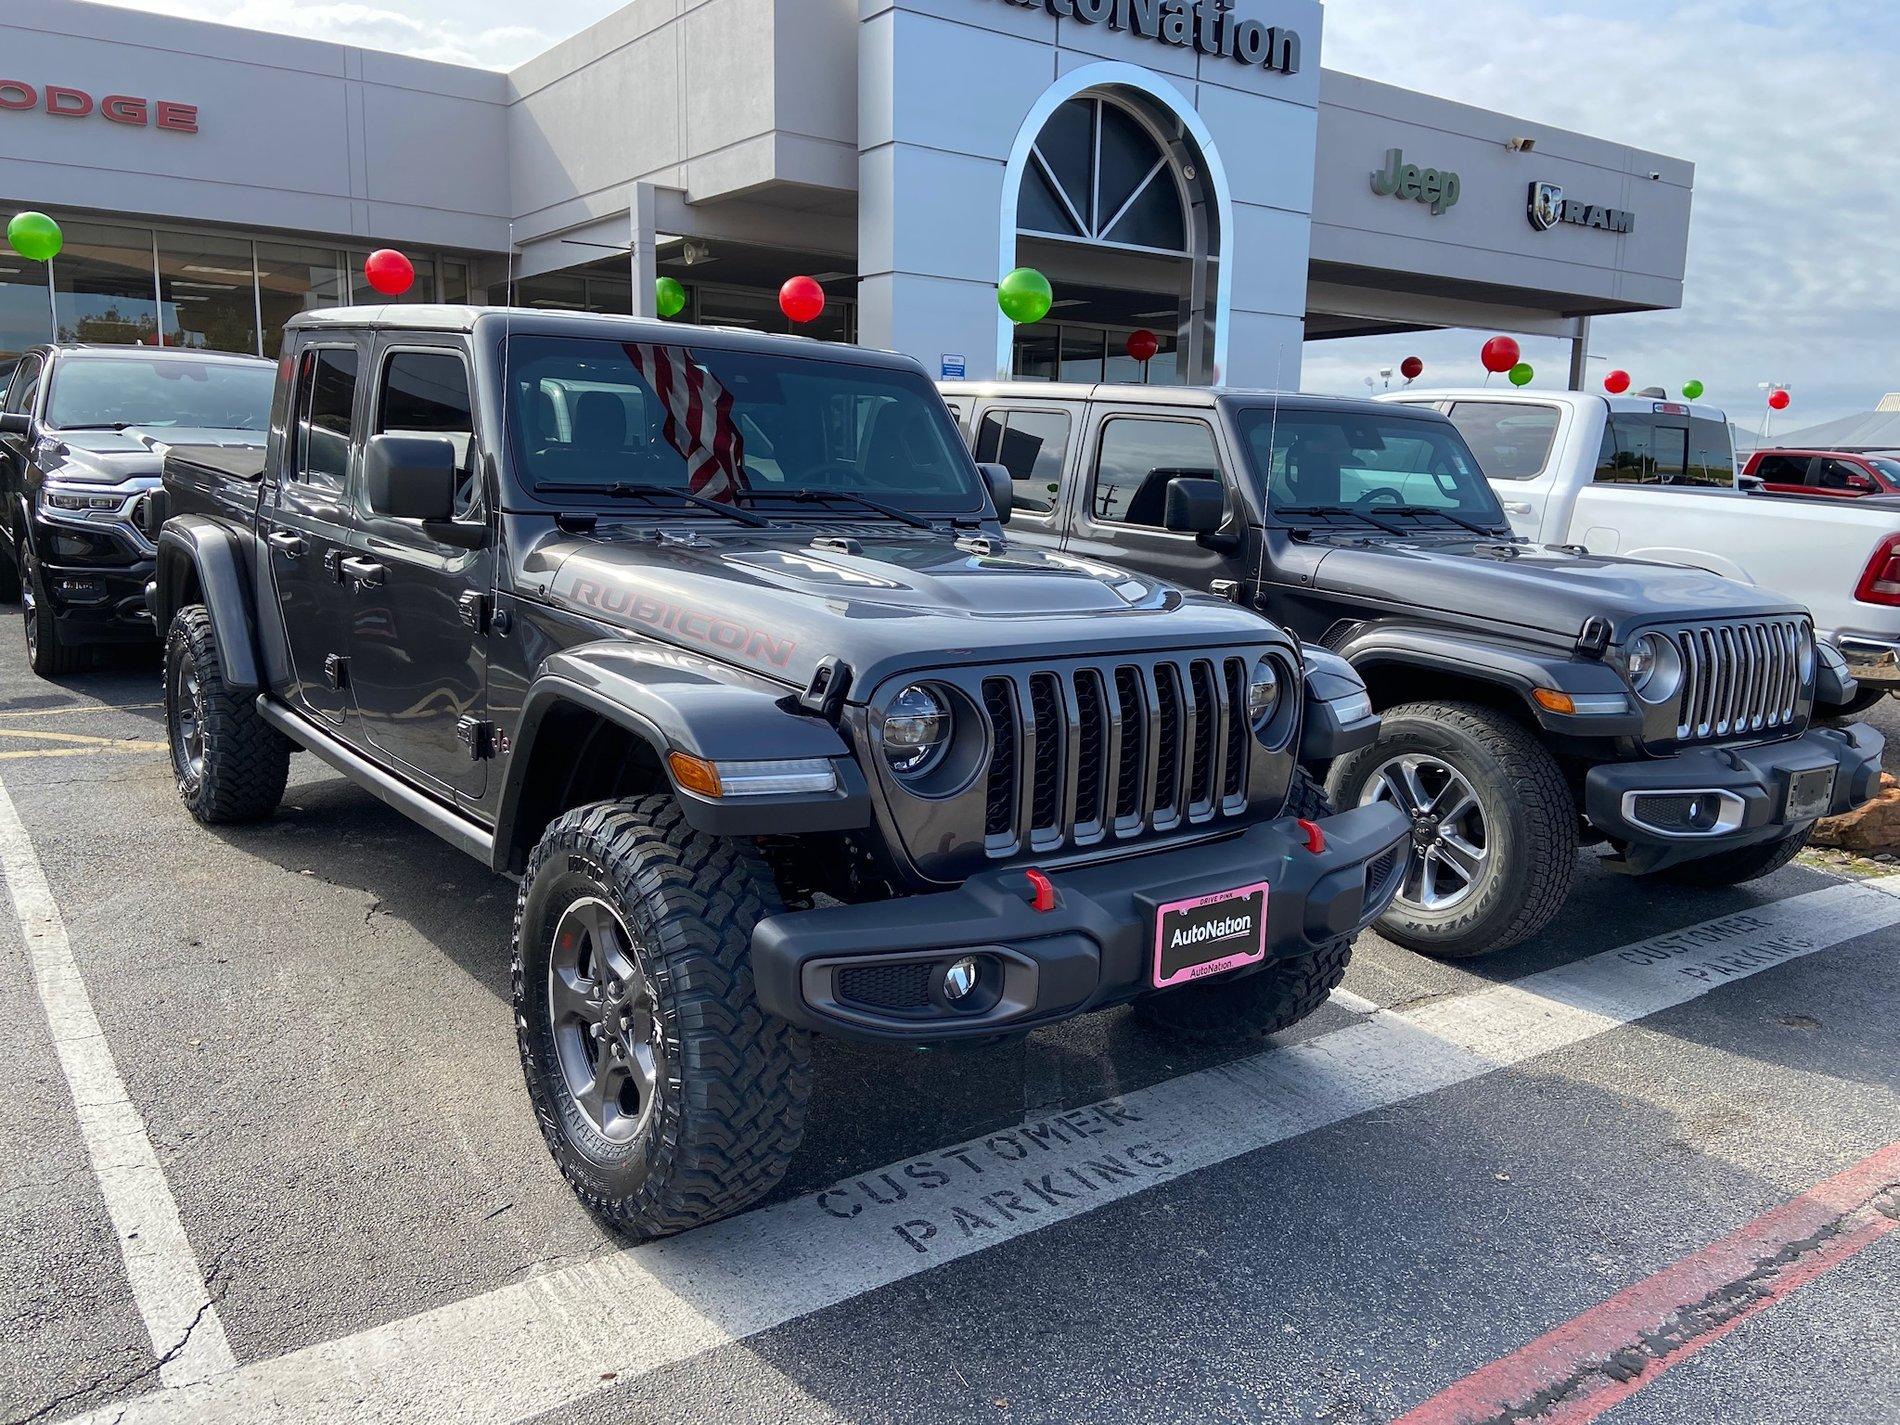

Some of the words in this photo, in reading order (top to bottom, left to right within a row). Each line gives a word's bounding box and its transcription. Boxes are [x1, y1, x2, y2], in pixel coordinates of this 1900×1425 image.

[1369, 148, 1460, 215] Jeep
[1561, 200, 1634, 233] RAM
[569, 577, 797, 668] RUBICON
[1199, 895, 1218, 905] DRIVE
[1219, 893, 1233, 901] PINK
[1170, 915, 1251, 948] AutoNation
[1617, 915, 1774, 966] CUSTOMER
[1190, 961, 1233, 978] AutoNation
[1678, 935, 1814, 982] PARKING
[816, 1100, 1144, 1219] CUSTOMER
[891, 1142, 1173, 1253] PARKING
